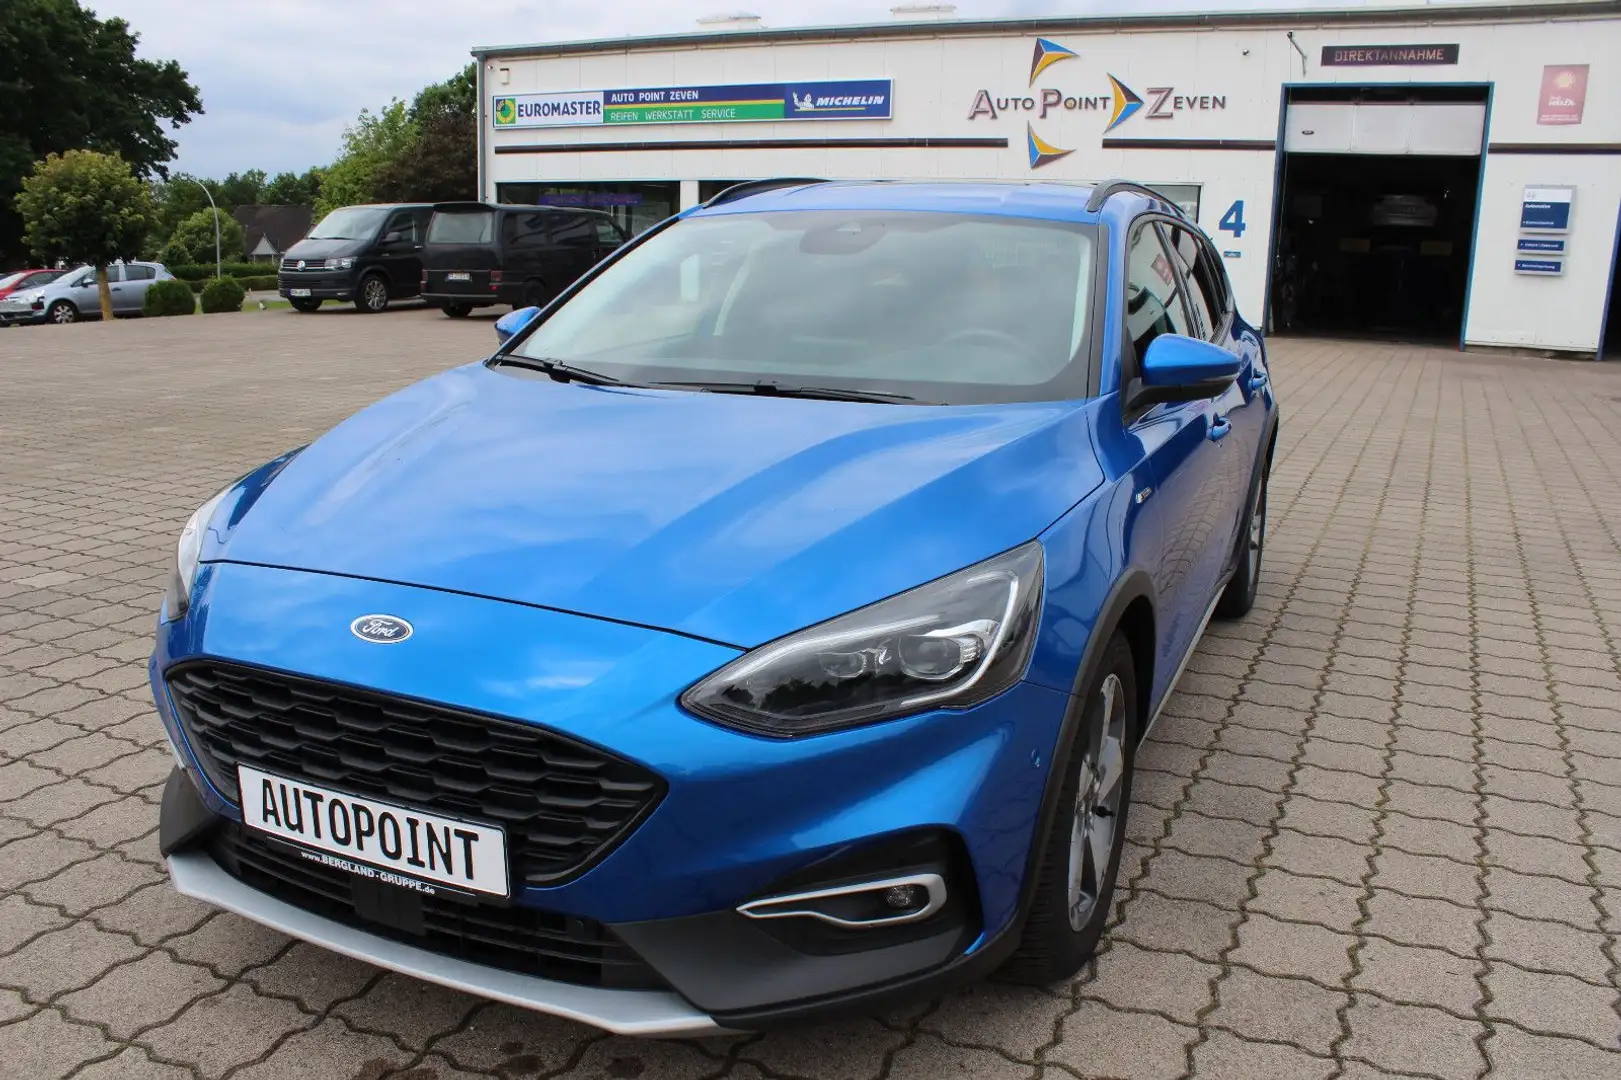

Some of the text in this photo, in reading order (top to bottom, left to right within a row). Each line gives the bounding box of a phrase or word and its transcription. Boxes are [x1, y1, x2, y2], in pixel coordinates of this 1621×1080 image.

[1334, 48, 1444, 62] DIREKTANNAHME
[611, 90, 699, 102] AUTO POINT ZEVEN
[815, 94, 885, 107] MICHELIN
[517, 100, 601, 118] EUROMASTER
[610, 108, 736, 121] REIFEN WERKSTATT SERVICE
[1218, 200, 1246, 238] 4
[362, 619, 400, 637] Ford
[262, 778, 480, 880] AUTOPOINT
